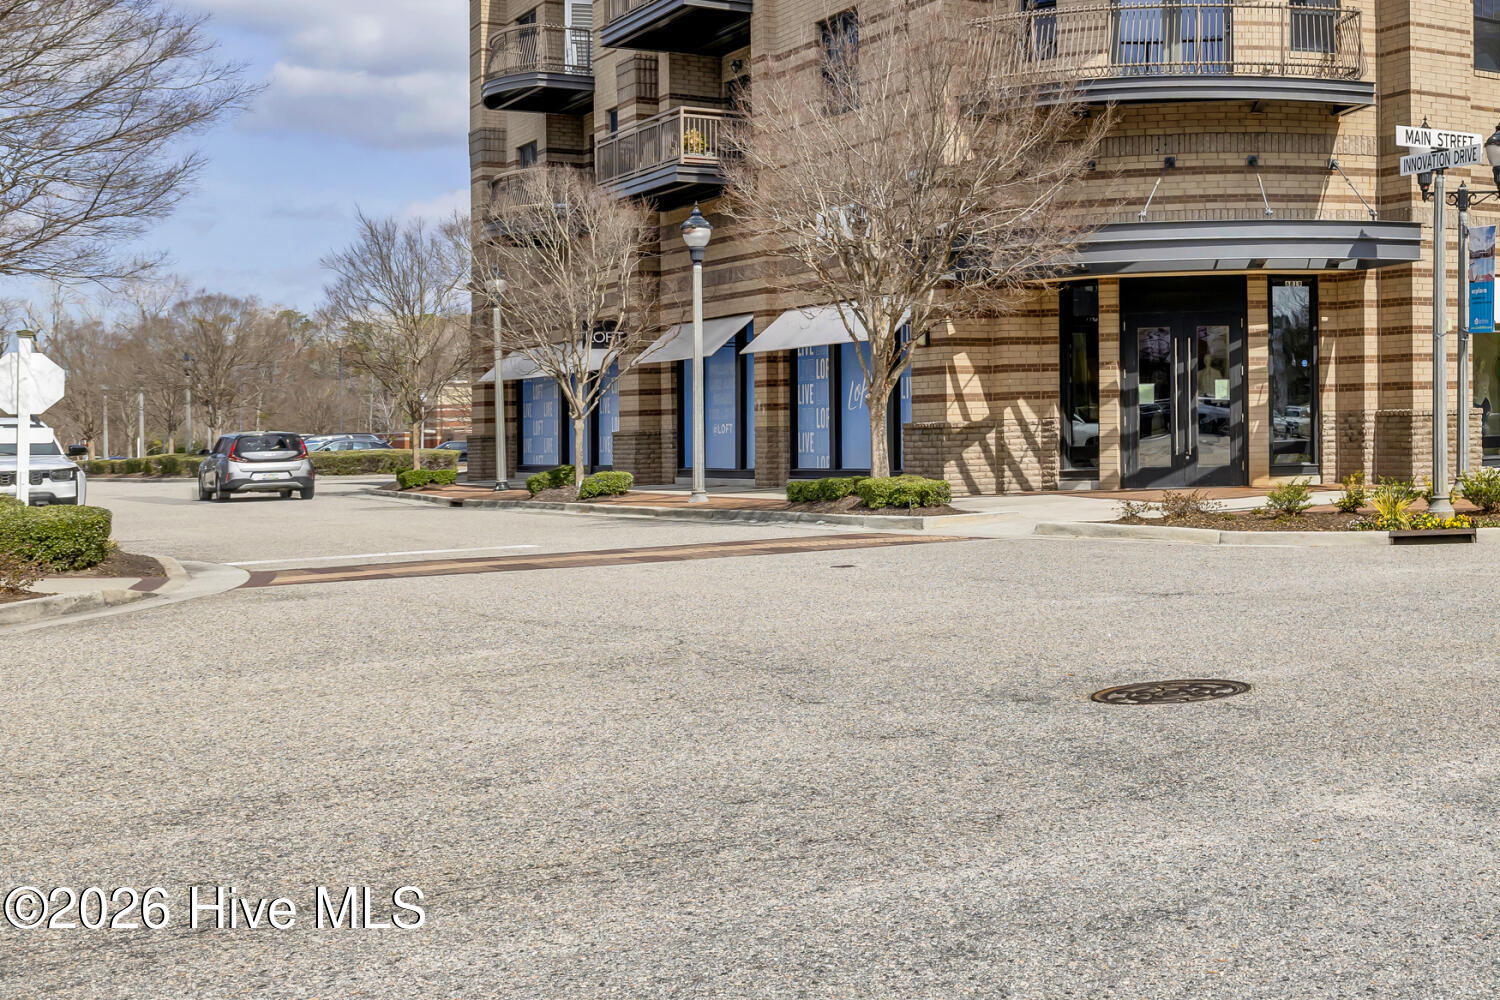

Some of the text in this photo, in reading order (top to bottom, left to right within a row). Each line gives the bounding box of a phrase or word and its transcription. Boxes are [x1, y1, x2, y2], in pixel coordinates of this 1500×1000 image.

[1405, 129, 1474, 148] MAIN STREET
[1404, 147, 1477, 172] INNOVATION DRIVE
[586, 330, 624, 343] LOFT
[798, 384, 814, 404] LIVE
[798, 432, 814, 453] LIVE
